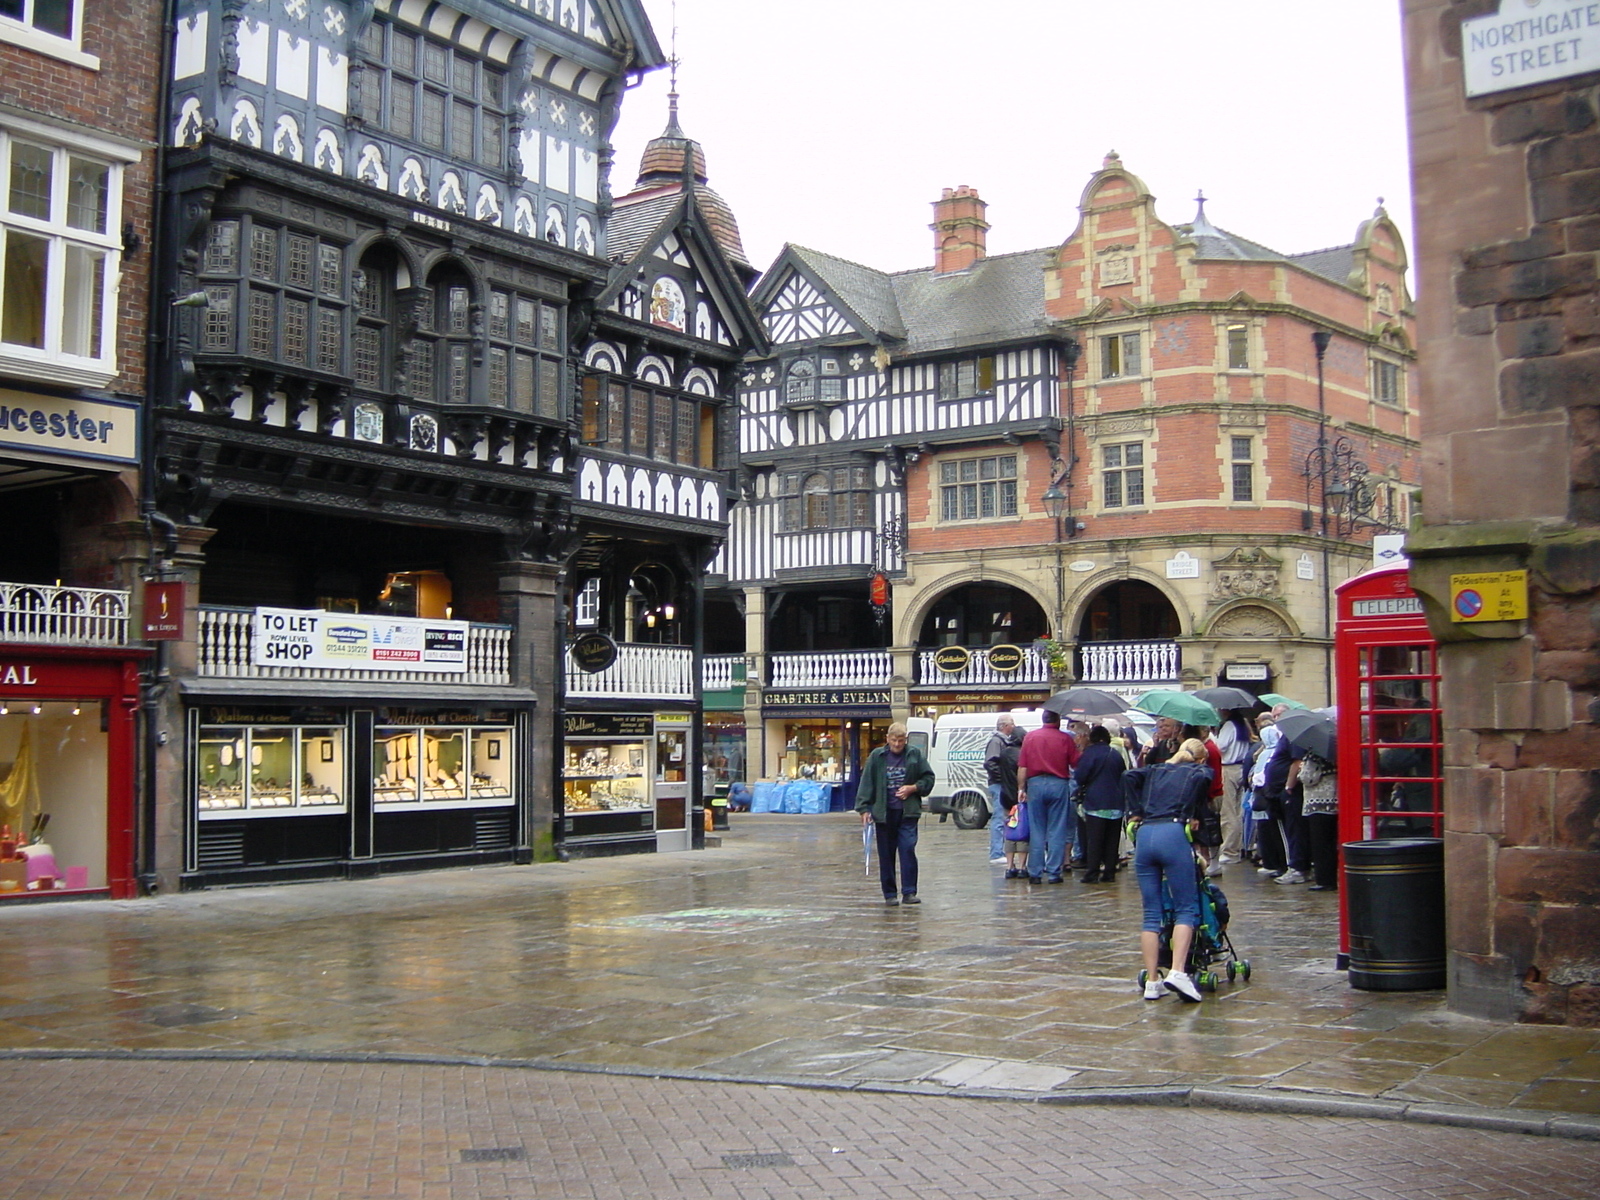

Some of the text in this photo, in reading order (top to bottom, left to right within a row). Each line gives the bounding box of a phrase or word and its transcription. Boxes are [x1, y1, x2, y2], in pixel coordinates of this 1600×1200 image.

[1471, 4, 1600, 52] NORTHGATE
[1491, 38, 1581, 77] STREET
[1453, 576, 1500, 585] Pedestrian
[262, 614, 318, 632] TO LET
[265, 642, 313, 660] SHOP
[0, 665, 37, 685] AL
[765, 692, 890, 704] CRABTREE & EVELYN
[949, 752, 985, 760] HIGHWA
